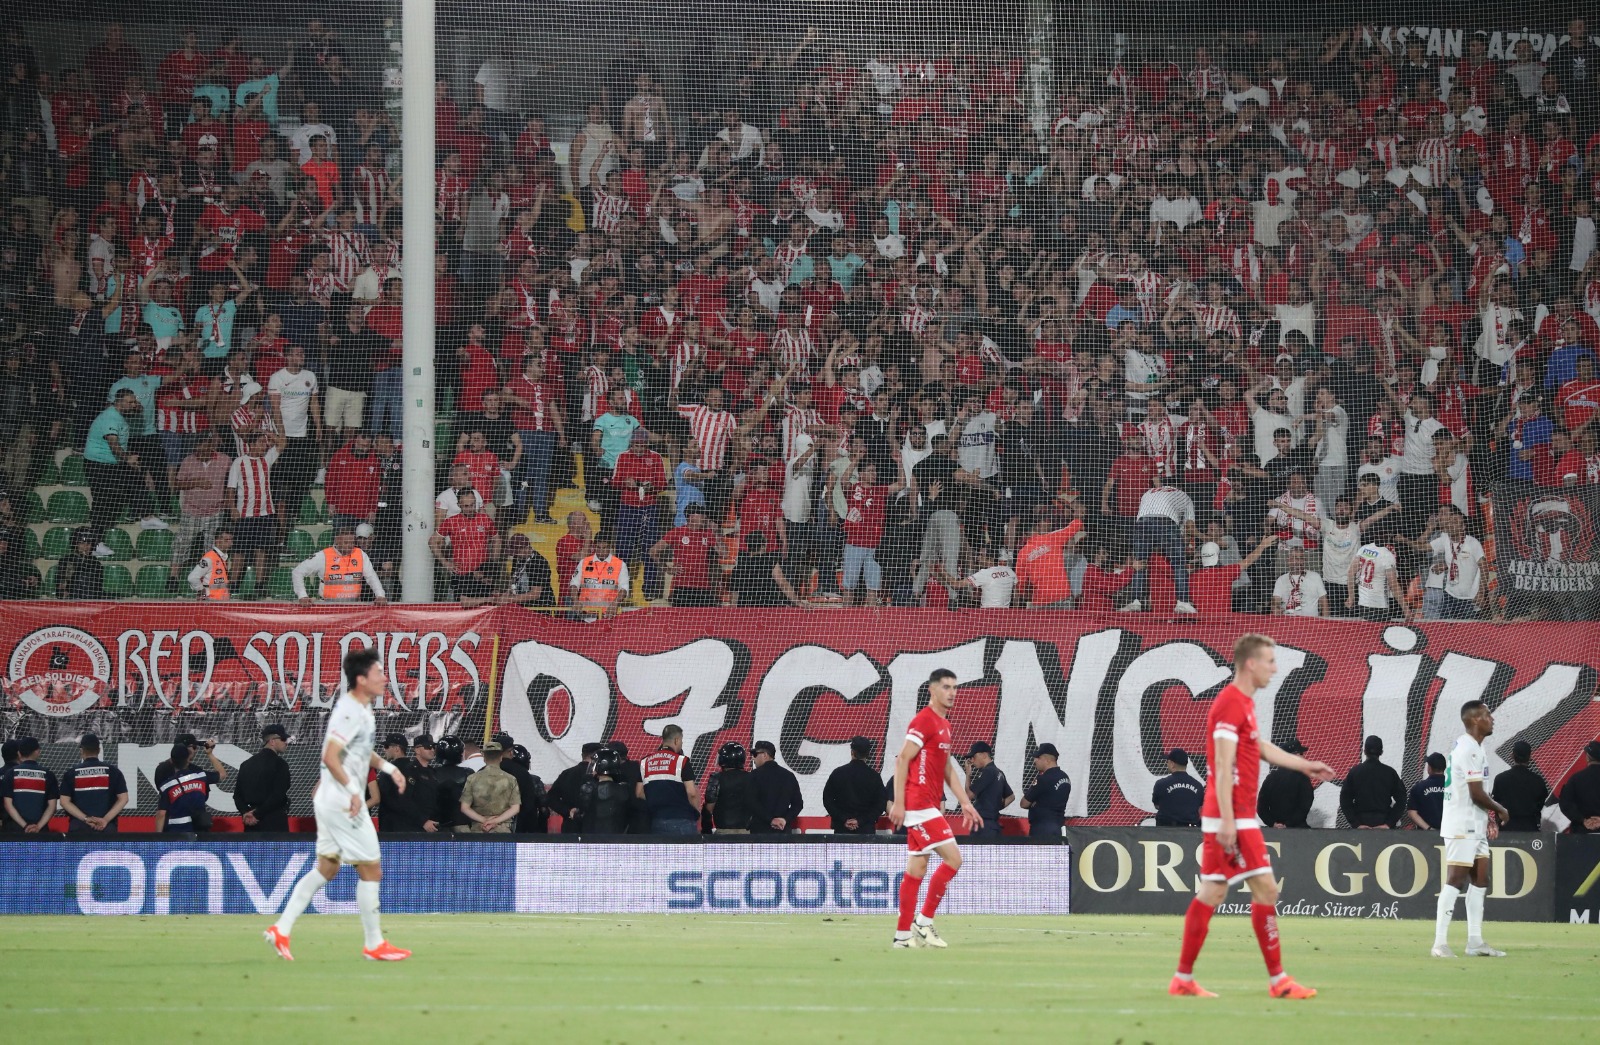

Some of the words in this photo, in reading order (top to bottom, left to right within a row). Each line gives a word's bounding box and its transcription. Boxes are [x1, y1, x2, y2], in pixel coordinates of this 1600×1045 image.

[1508, 560, 1600, 577] ANTALYASPOR
[1515, 575, 1594, 591] DEFENDERS
[117, 629, 215, 712] RED
[243, 631, 481, 713] SOLDIERS
[20, 673, 44, 688] RED
[46, 705, 71, 713] 2006
[1167, 782, 1198, 794] JANDARMA
[1320, 901, 1365, 917] Sürer
